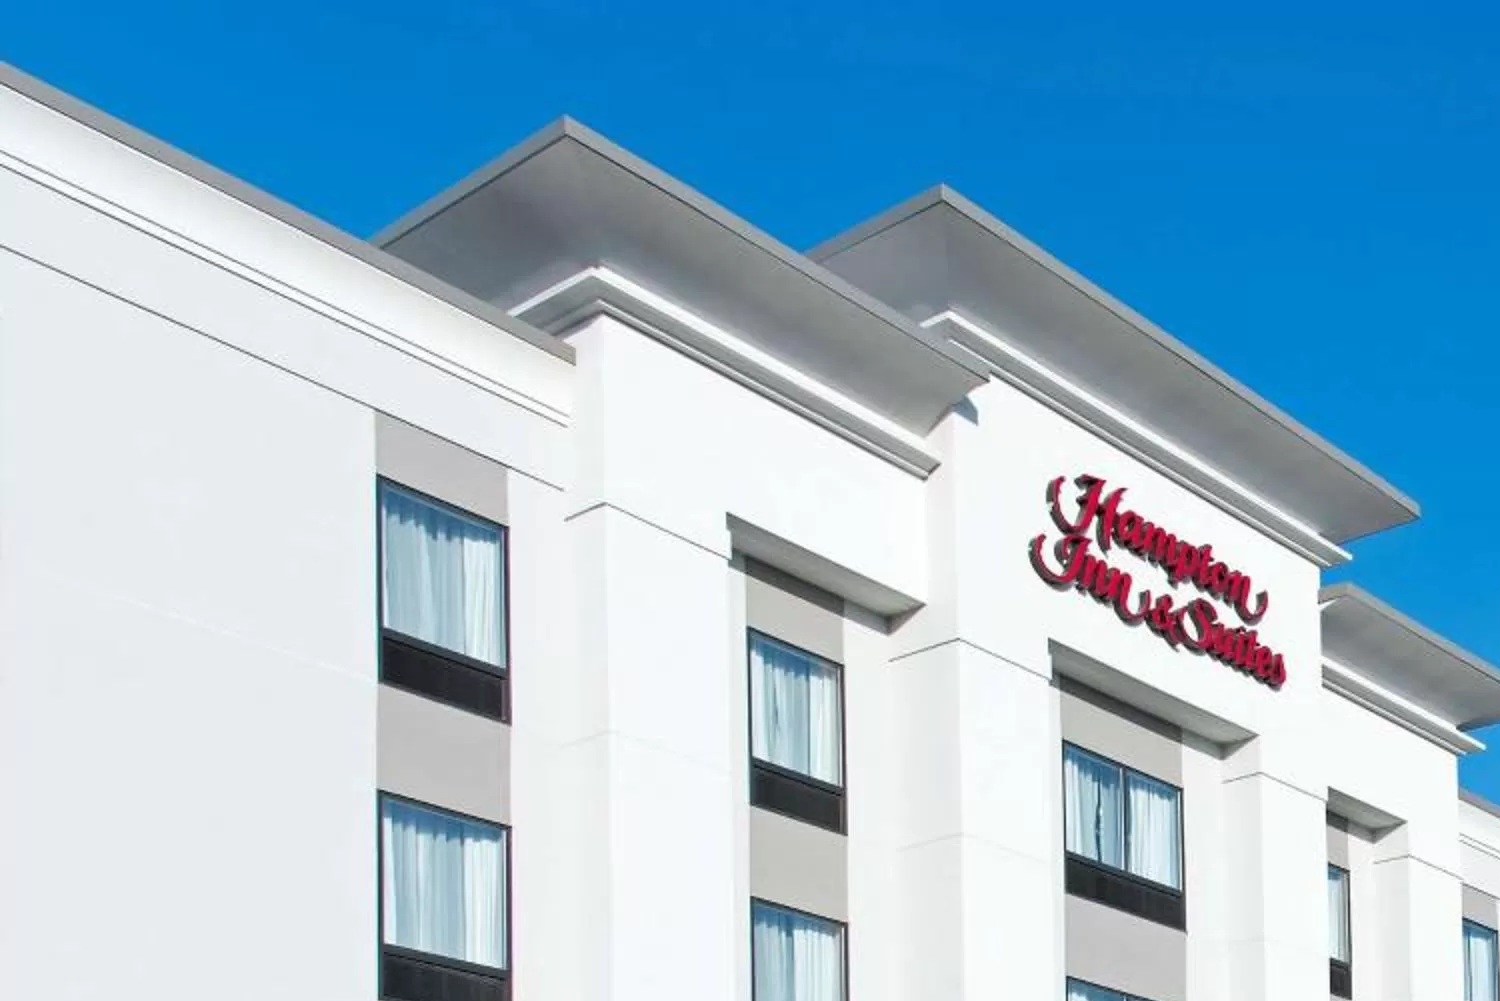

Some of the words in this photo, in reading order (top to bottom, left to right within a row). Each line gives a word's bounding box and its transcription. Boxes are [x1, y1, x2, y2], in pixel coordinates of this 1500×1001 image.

[1028, 534, 1151, 627] Inn
[1145, 594, 1179, 652] &
[1176, 598, 1286, 691] Suites
[1046, 474, 1268, 625] Hampton
